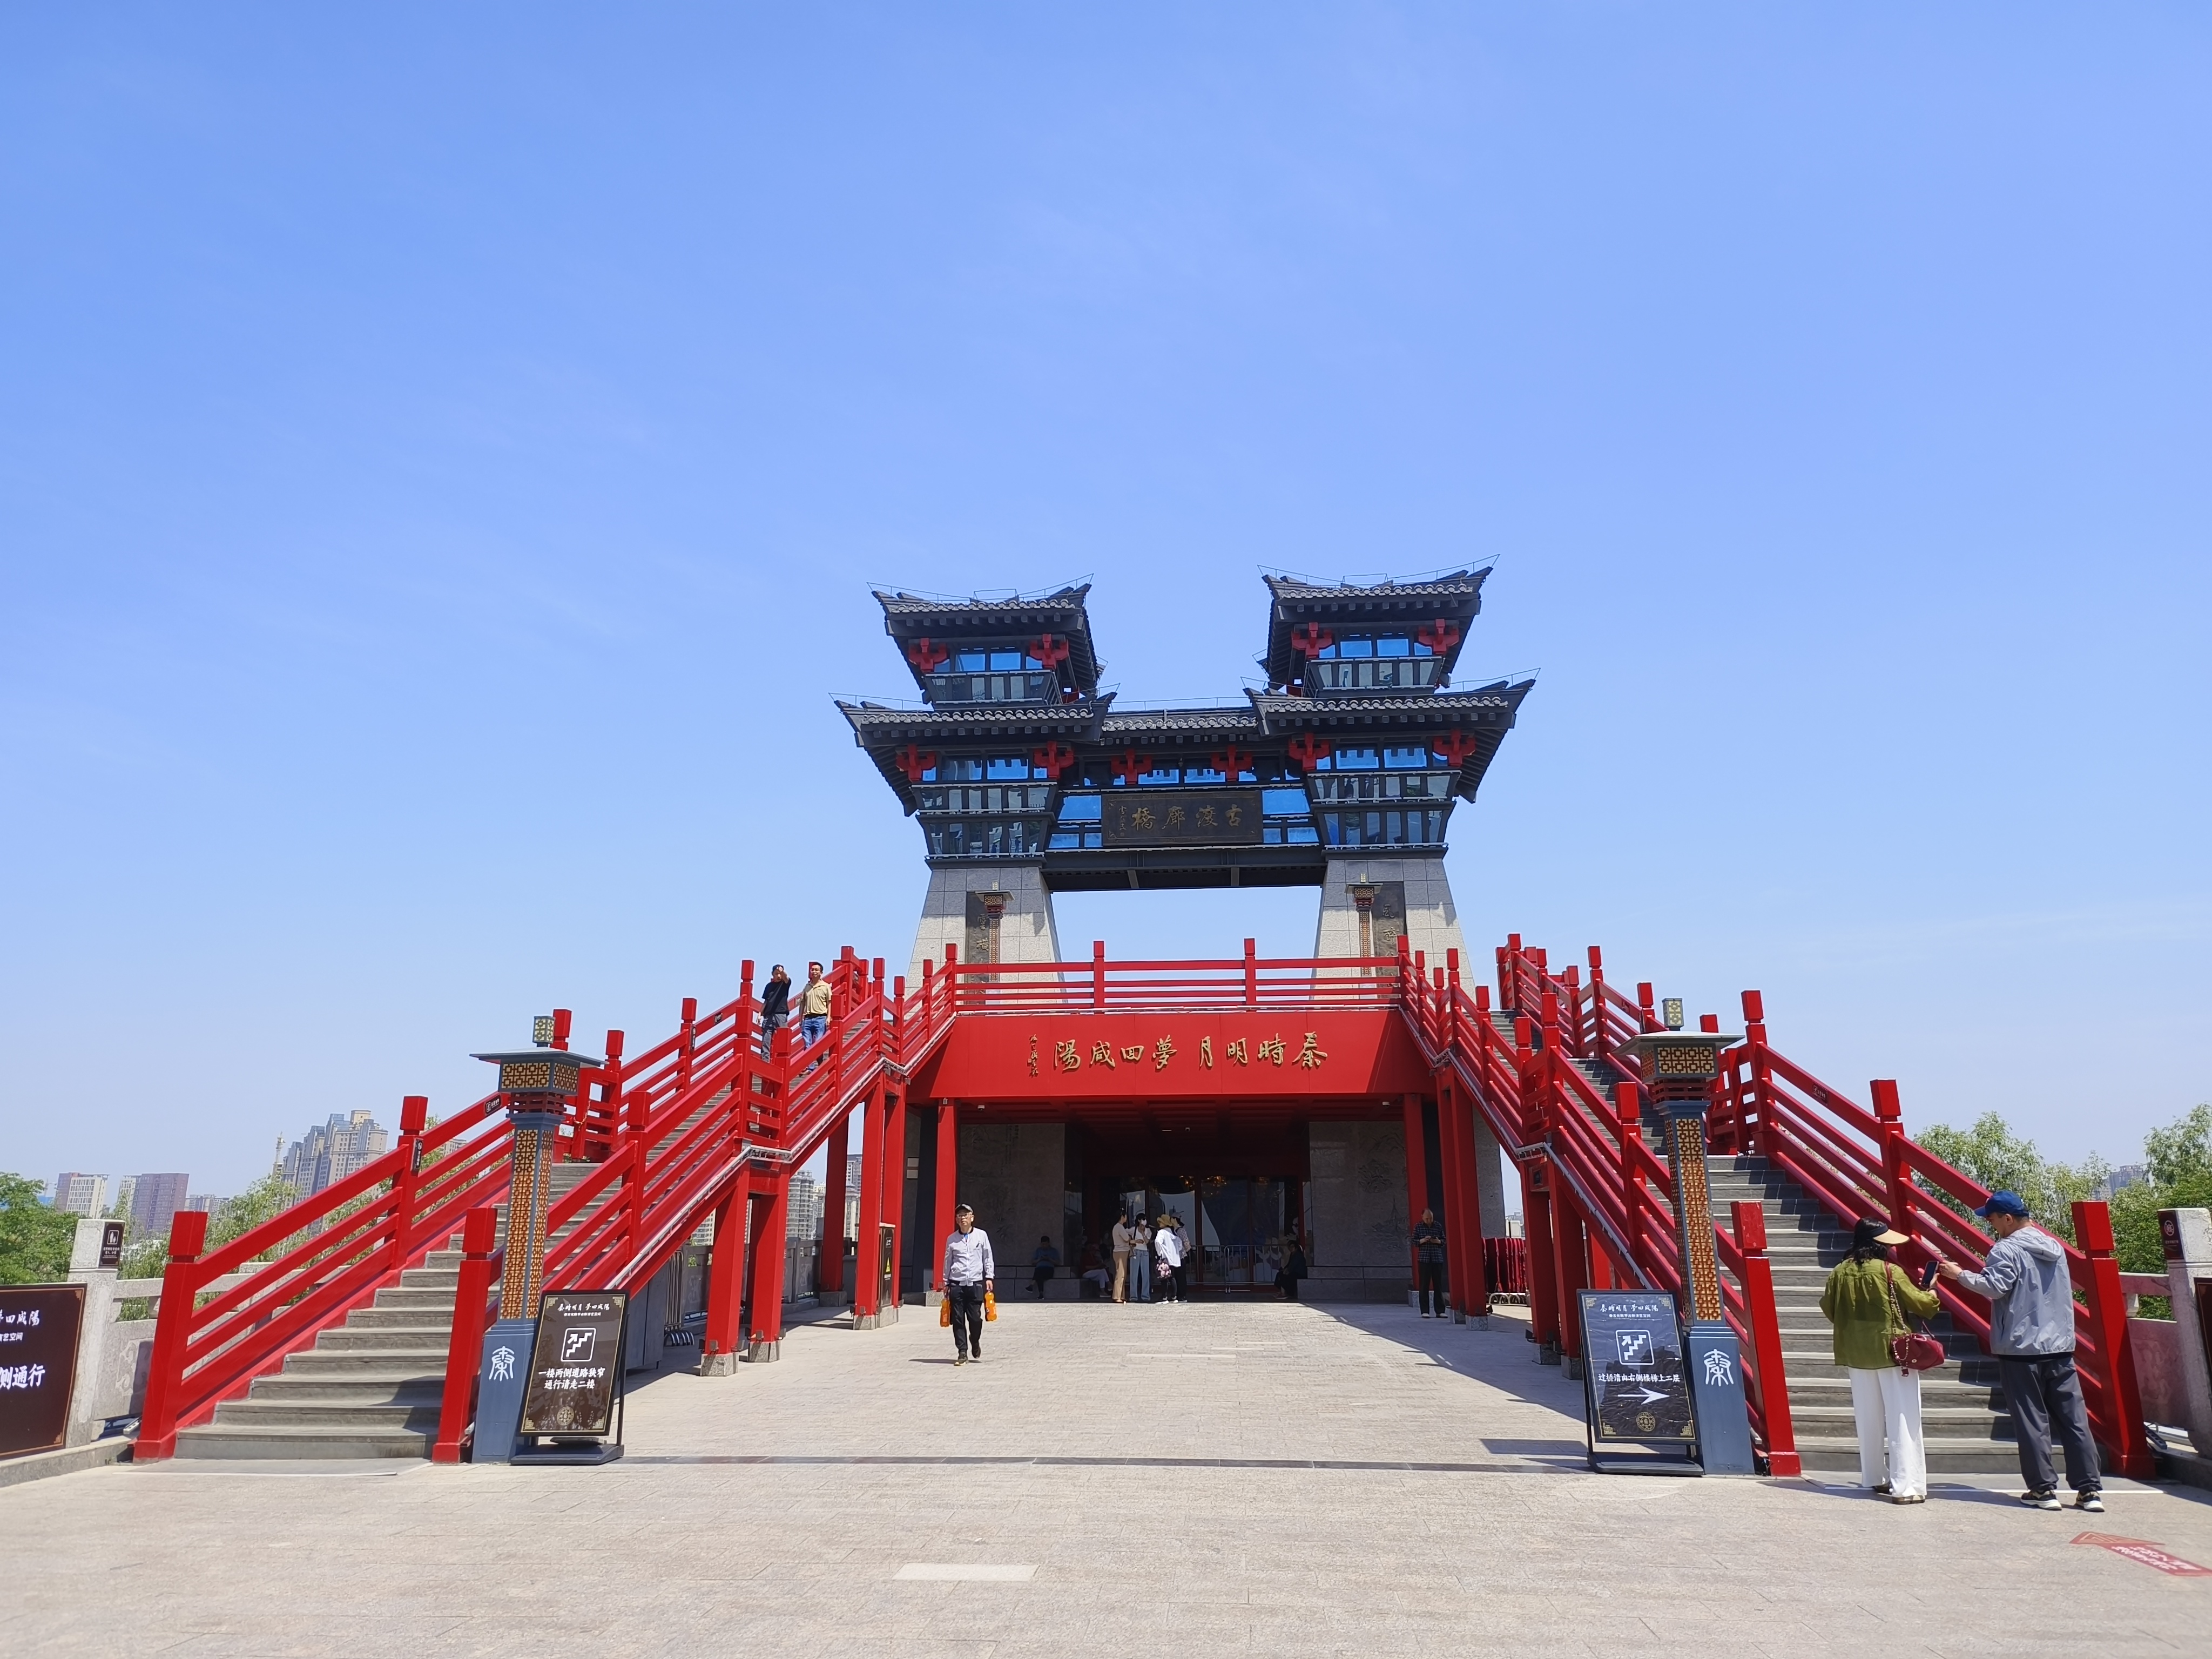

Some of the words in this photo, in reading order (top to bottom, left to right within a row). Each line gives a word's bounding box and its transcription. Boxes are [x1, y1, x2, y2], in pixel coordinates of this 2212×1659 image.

[538, 1367, 605, 1378] 一楼两侧道路狭窄
[1598, 1373, 1681, 1382] 过桥请由右侧楼梯上二层
[544, 1379, 595, 1390] 通行请走二楼
